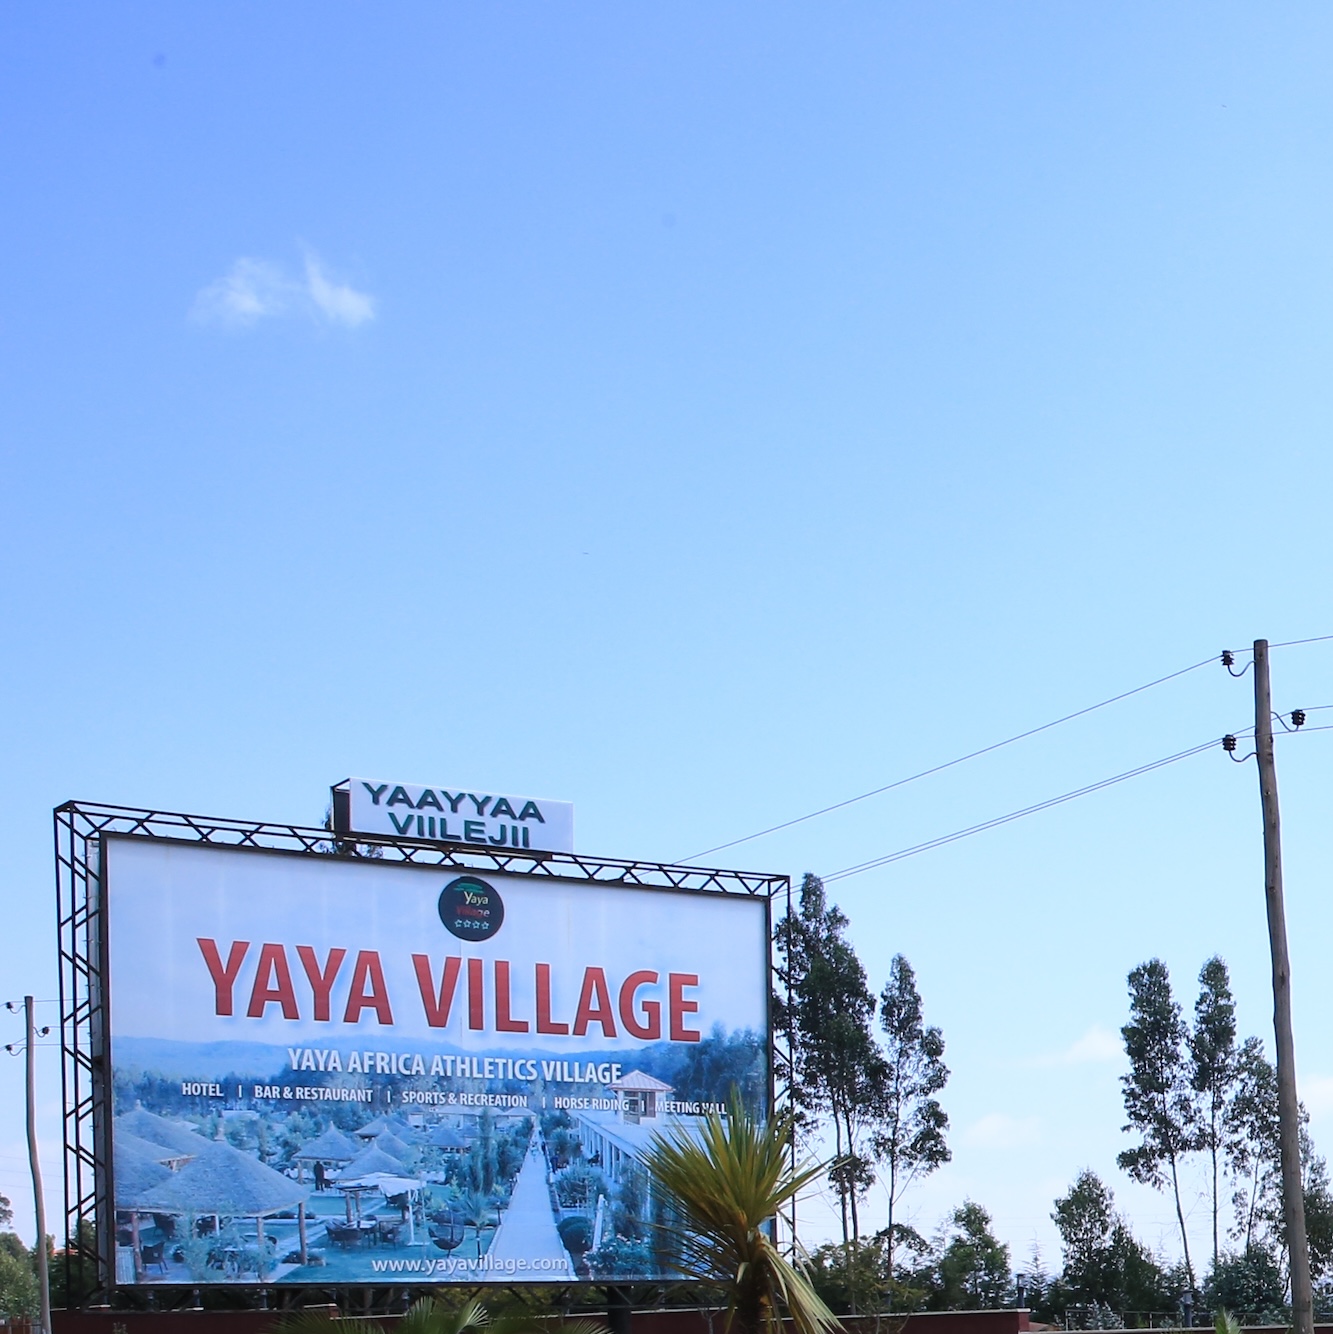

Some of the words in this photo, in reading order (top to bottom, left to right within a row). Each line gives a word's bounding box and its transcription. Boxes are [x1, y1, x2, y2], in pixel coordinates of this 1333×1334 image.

[361, 781, 546, 824] YAAYYAA
[388, 811, 531, 849] VIILEJII
[463, 890, 489, 906] Yaya
[196, 937, 395, 1026] YAYA
[411, 953, 701, 1042] VILLAGE
[288, 1047, 343, 1072] YAYA
[347, 1051, 426, 1076] AFRICA
[430, 1054, 538, 1081] ATHLETICS
[541, 1060, 622, 1084] VILLAGE
[182, 1082, 224, 1097] HOTEL
[254, 1085, 281, 1099] BAR
[282, 1086, 294, 1100] &
[296, 1087, 373, 1102] RESTAURANT
[402, 1091, 446, 1105] SPORTS
[448, 1092, 458, 1105] &
[460, 1092, 527, 1108] RECREATION
[554, 1097, 589, 1110] HORSE
[592, 1098, 630, 1111] RIDING
[655, 1101, 700, 1114] MEETING
[372, 1254, 568, 1276] www.yayavillage.com
